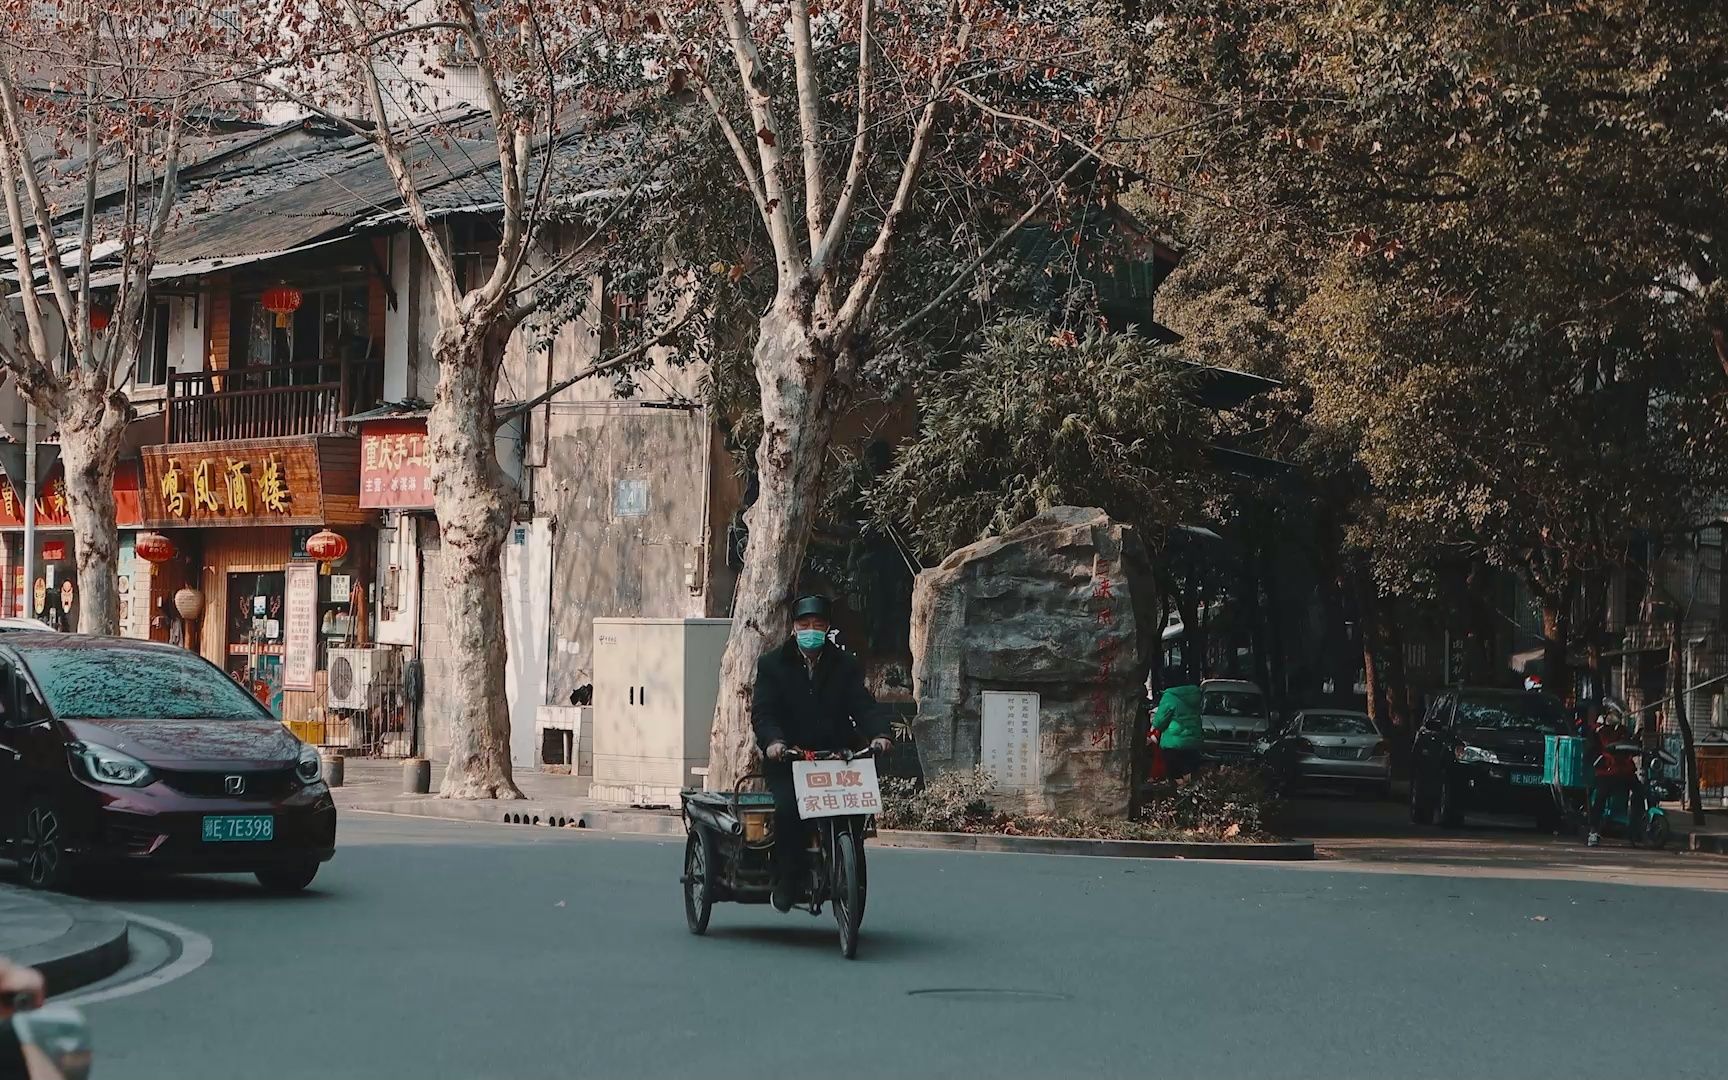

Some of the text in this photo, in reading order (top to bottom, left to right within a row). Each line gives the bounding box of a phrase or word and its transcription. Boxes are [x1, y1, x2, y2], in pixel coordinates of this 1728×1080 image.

[161, 452, 285, 517] 鸣凤酒楼
[806, 769, 863, 788] 回收
[804, 792, 878, 812] 家电废品
